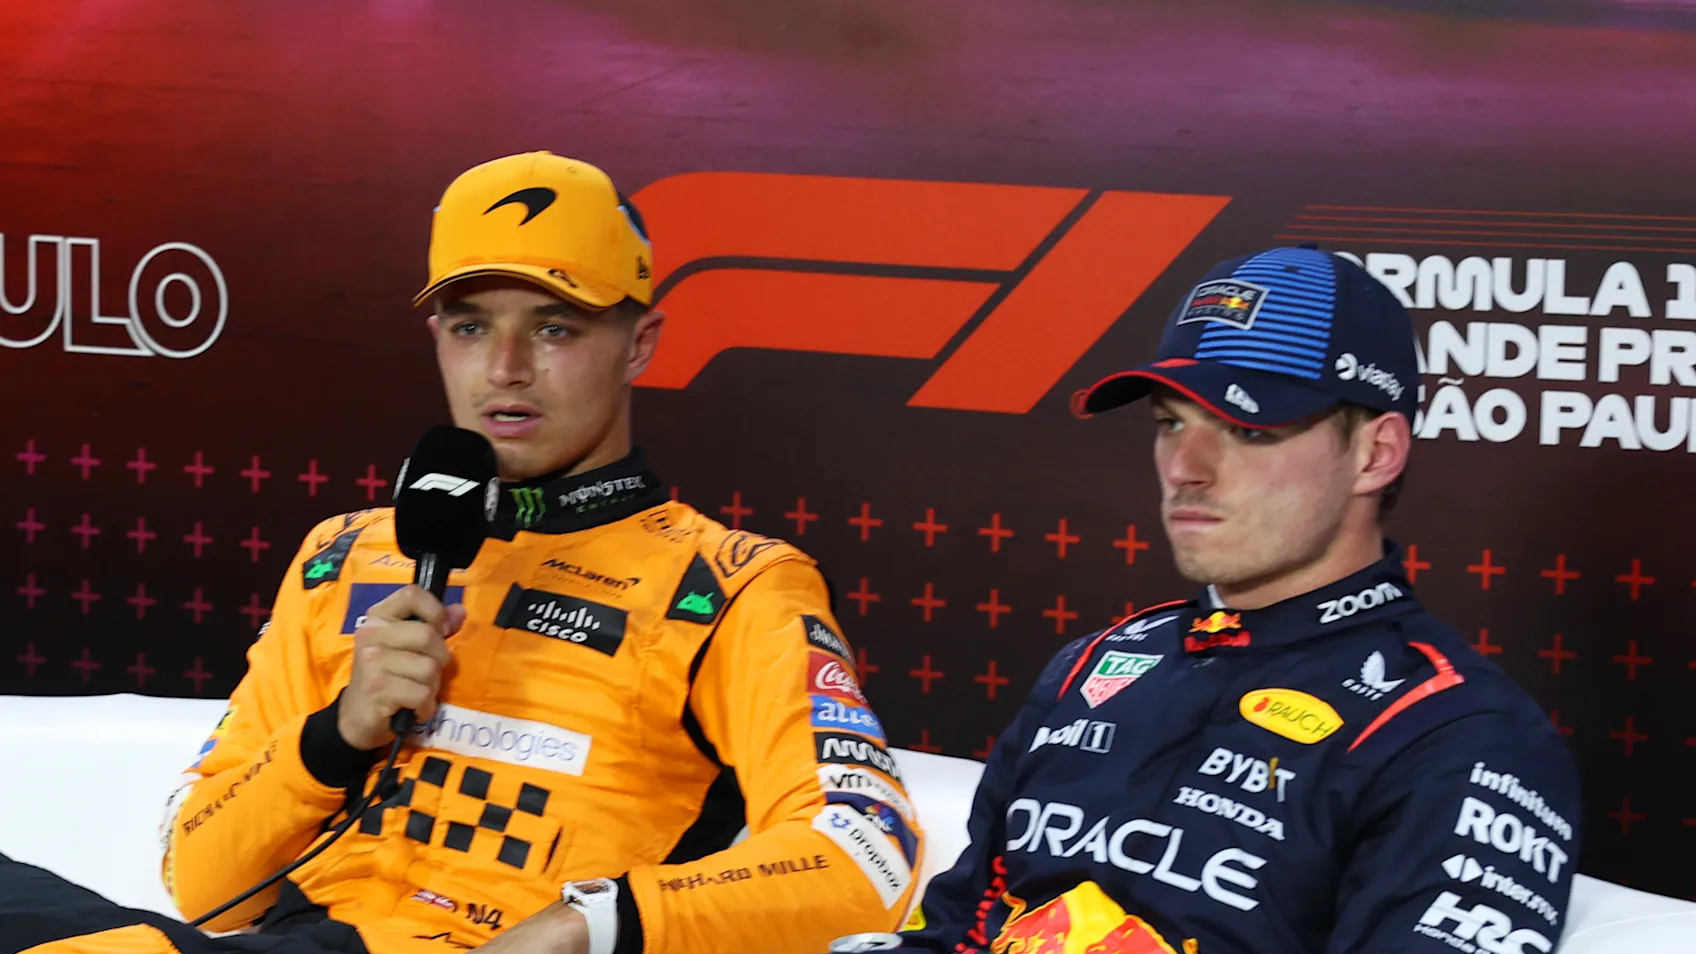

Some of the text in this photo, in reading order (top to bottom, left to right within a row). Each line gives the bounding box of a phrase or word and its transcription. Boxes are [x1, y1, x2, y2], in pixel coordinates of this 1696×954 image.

[1334, 251, 1653, 318] RMULA
[1414, 319, 1589, 382] NDE
[1412, 377, 1696, 454] ÃO PAU
[540, 558, 634, 591] McLaren
[1104, 656, 1156, 675] TAG
[1267, 701, 1332, 738] RAUCH
[1197, 746, 1297, 804] BYBIT
[1469, 760, 1573, 841] infinitum
[1172, 785, 1286, 842] HONDA
[1454, 796, 1569, 884] ROKT
[757, 853, 832, 878] MILLE
[1006, 797, 1268, 912] ORACLE
